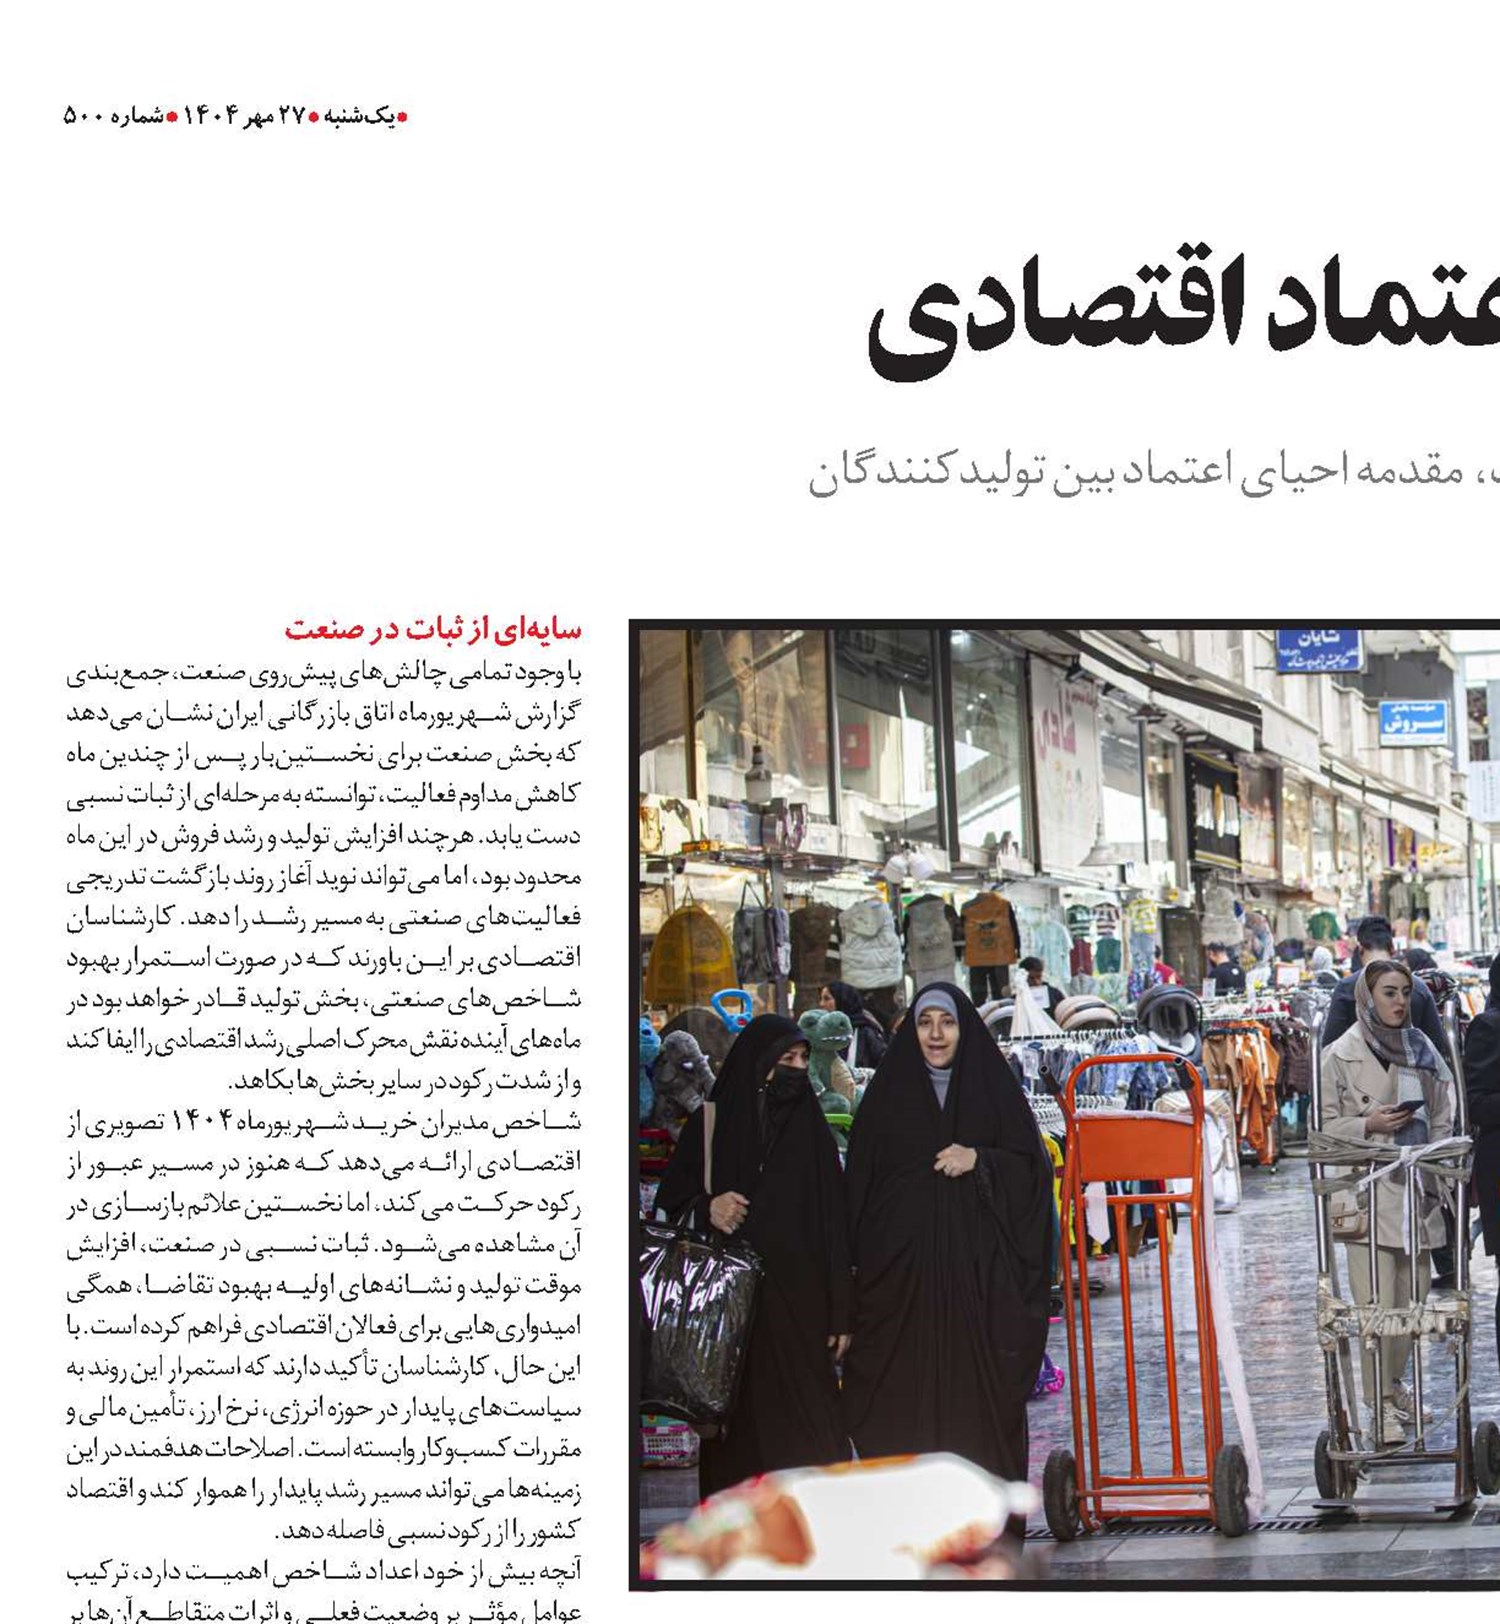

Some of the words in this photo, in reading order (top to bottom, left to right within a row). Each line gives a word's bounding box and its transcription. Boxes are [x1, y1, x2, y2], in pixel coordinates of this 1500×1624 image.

[64, 106, 101, 124] ۵۰۰
[111, 106, 163, 128] شماره
[185, 104, 238, 124] ۱۴۰۴
[243, 113, 273, 130] مهر
[279, 105, 305, 124] ۲۷
[869, 242, 1244, 383] اقتصادی
[1124, 449, 1230, 484] اعتماد
[1242, 449, 1347, 498] احیای
[1358, 453, 1462, 483] مقدمه
[1054, 465, 1114, 498] بین
[285, 620, 364, 640] صنعت
[369, 623, 398, 645] در
[407, 615, 463, 647] ثبات
[467, 615, 488, 645] از
[450, 660, 512, 689] تمامی
[516, 667, 564, 688] وجود
[568, 659, 581, 685] با
[147, 700, 212, 730] نشان
[217, 700, 263, 729] ایران
[268, 699, 350, 731] بازرگانی
[355, 701, 394, 729] اتاق
[399, 701, 511, 729] شهریورماه
[516, 699, 581, 729] گزارش
[1384, 714, 1443, 733] سروش
[67, 786, 123, 812] نسبی
[127, 782, 174, 808] ثبات
[176, 782, 190, 810] از
[283, 789, 300, 808] به
[305, 782, 376, 810] توانسته
[459, 782, 511, 812] مداوم
[516, 782, 581, 811] کاهش
[67, 868, 146, 894] تدریجی
[150, 863, 229, 892] بازگشت
[234, 868, 274, 893] روند
[277, 860, 311, 892] آغاز
[316, 867, 356, 893] نوید
[445, 864, 467, 884] اما
[514, 871, 581, 893] محدود
[67, 904, 175, 934] کارشناسان
[235, 905, 248, 933] را
[252, 906, 305, 933] رشد
[311, 917, 362, 933] مسیر
[366, 912, 384, 931] به
[389, 909, 461, 934] صنعتی
[67, 952, 119, 975] بهبود
[122, 945, 210, 975] استمرار
[215, 951, 276, 975] صورت
[279, 952, 302, 975] در
[306, 945, 345, 966] که
[349, 946, 401, 975] باورند
[407, 945, 451, 975] این
[456, 957, 473, 975] بر
[478, 945, 580, 975] اقتصادی
[66, 994, 87, 1015] در
[93, 994, 122, 1015] بود
[126, 987, 189, 1015] خواهد
[192, 987, 245, 1015] قادر
[251, 987, 300, 1015] تولید
[304, 988, 358, 1015] بخش
[376, 1069, 421, 1097] سایر
[424, 1076, 446, 1097] در
[450, 1068, 493, 1097] رکود
[496, 1070, 550, 1089] شدت
[554, 1068, 568, 1097] از
[571, 1080, 581, 1097] و
[67, 1109, 80, 1138] از
[85, 1114, 164, 1139] تصویری
[174, 1109, 232, 1130] ۱۴۰۴
[237, 1109, 348, 1138] شهریورماه
[353, 1111, 417, 1138] خرید
[421, 1109, 488, 1139] مدیران
[492, 1109, 581, 1139] شاخص
[66, 1199, 87, 1220] در
[93, 1190, 184, 1220] بازسازی
[188, 1191, 240, 1219] علائم
[245, 1192, 342, 1220] نخستین
[348, 1191, 369, 1211] اما
[458, 1191, 533, 1220] حرکت
[538, 1190, 581, 1223] رکود
[67, 1232, 135, 1261] افزایش
[219, 1239, 240, 1260] در
[246, 1235, 317, 1261] نسبی
[322, 1232, 369, 1257] ثبات
[475, 1232, 554, 1253] مشاهده
[560, 1225, 580, 1261] آن
[67, 1272, 131, 1303] همگی
[219, 1281, 271, 1302] بهبود
[277, 1272, 334, 1302] اولیه
[457, 1284, 465, 1302] و
[470, 1272, 521, 1302] تولید
[525, 1273, 581, 1302] موقت
[67, 1314, 80, 1340] با
[141, 1312, 185, 1342] کرده
[188, 1314, 241, 1343] فراهم
[245, 1314, 331, 1342] اقتصادی
[336, 1314, 396, 1345] فعالان
[399, 1314, 441, 1342] برای
[67, 1436, 97, 1465] این
[101, 1444, 122, 1465] در
[125, 1436, 202, 1457] هدفمند
[206, 1436, 293, 1459] اصلاحات
[354, 1436, 415, 1465] وابسته
[513, 1436, 581, 1465] مقررات
[327, 1519, 384, 1538] فاصله
[388, 1522, 445, 1548] نسبی
[448, 1517, 490, 1547] رکود
[494, 1519, 508, 1547] از
[513, 1517, 525, 1547] را
[527, 1517, 581, 1547] کشور
[67, 1559, 129, 1587] ترکیب
[186, 1559, 267, 1585] اهمیت
[273, 1559, 361, 1588] شاخص
[366, 1559, 418, 1580] اعداد
[424, 1561, 463, 1588] خود
[469, 1559, 483, 1587] از
[489, 1563, 535, 1588] بیش
[540, 1555, 581, 1589] آنچه
